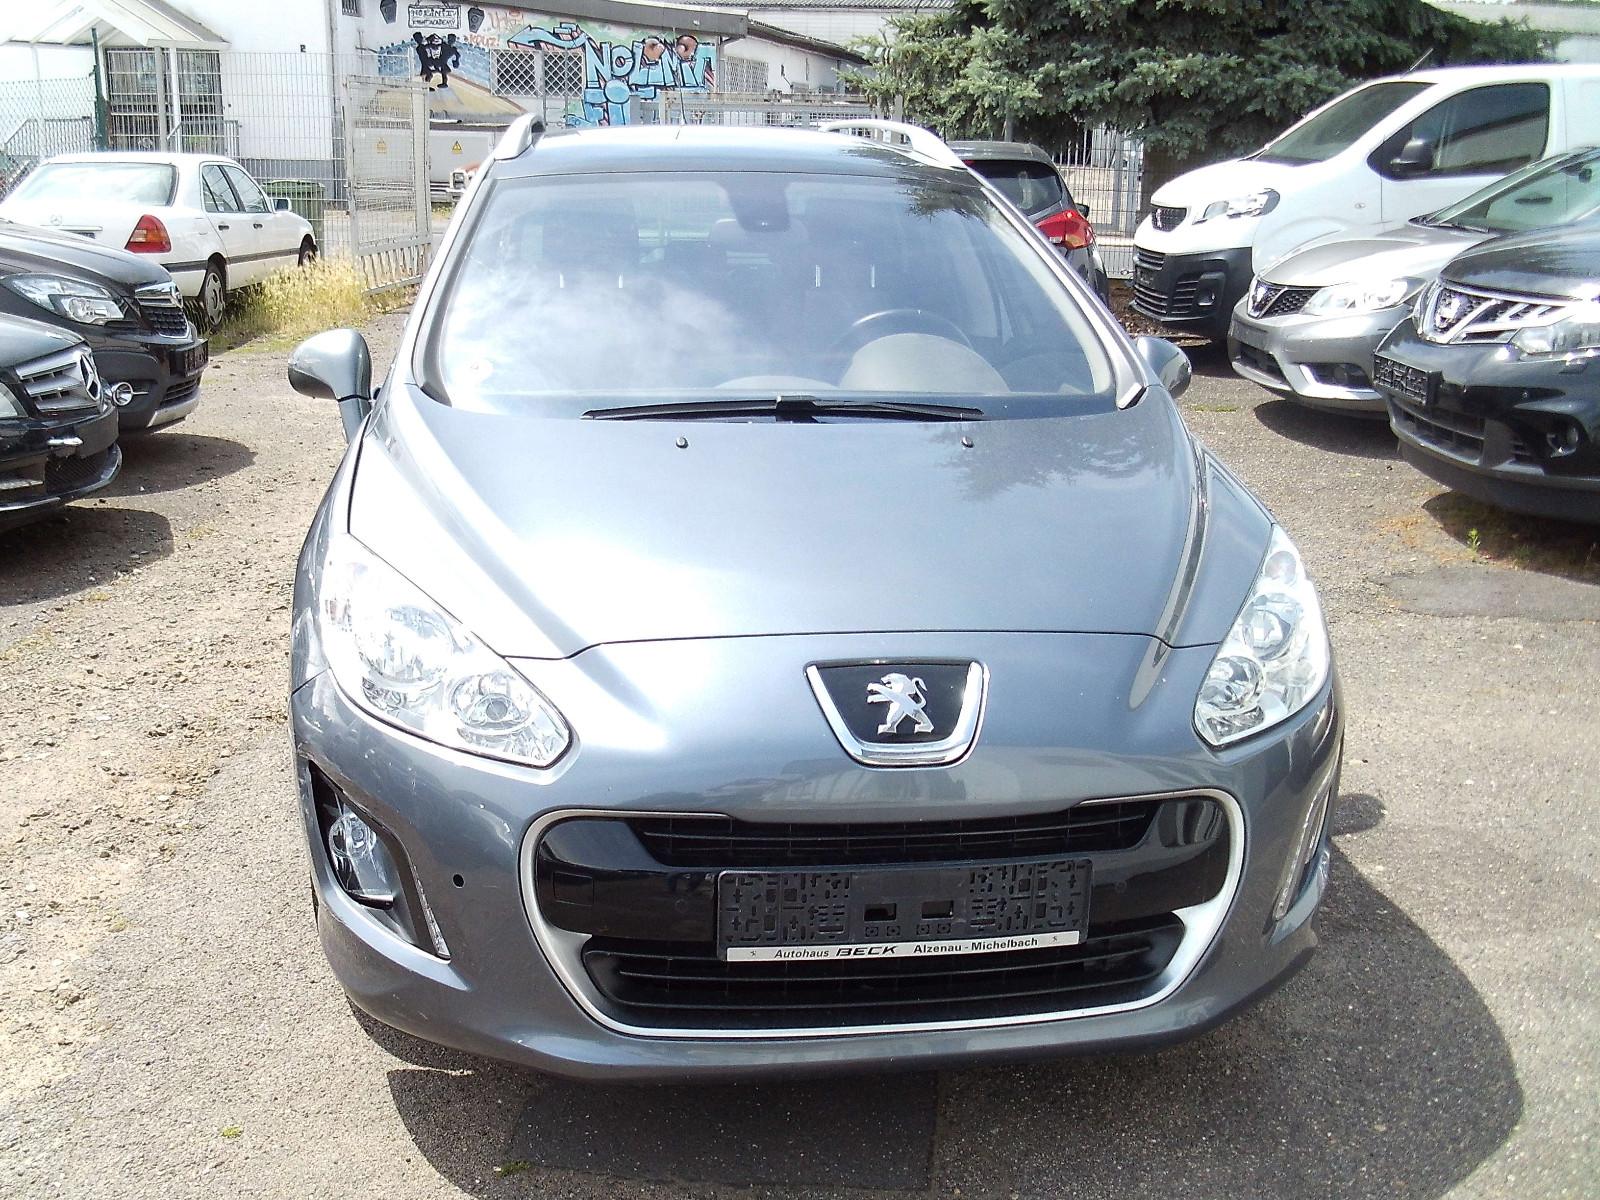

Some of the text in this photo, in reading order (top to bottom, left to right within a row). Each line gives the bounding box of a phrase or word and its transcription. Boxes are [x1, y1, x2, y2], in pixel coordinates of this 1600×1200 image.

[774, 948, 830, 959] Autohaus
[835, 945, 898, 957] BECK
[913, 944, 962, 954] Alzenau
[971, 937, 1038, 951] Michelbach
